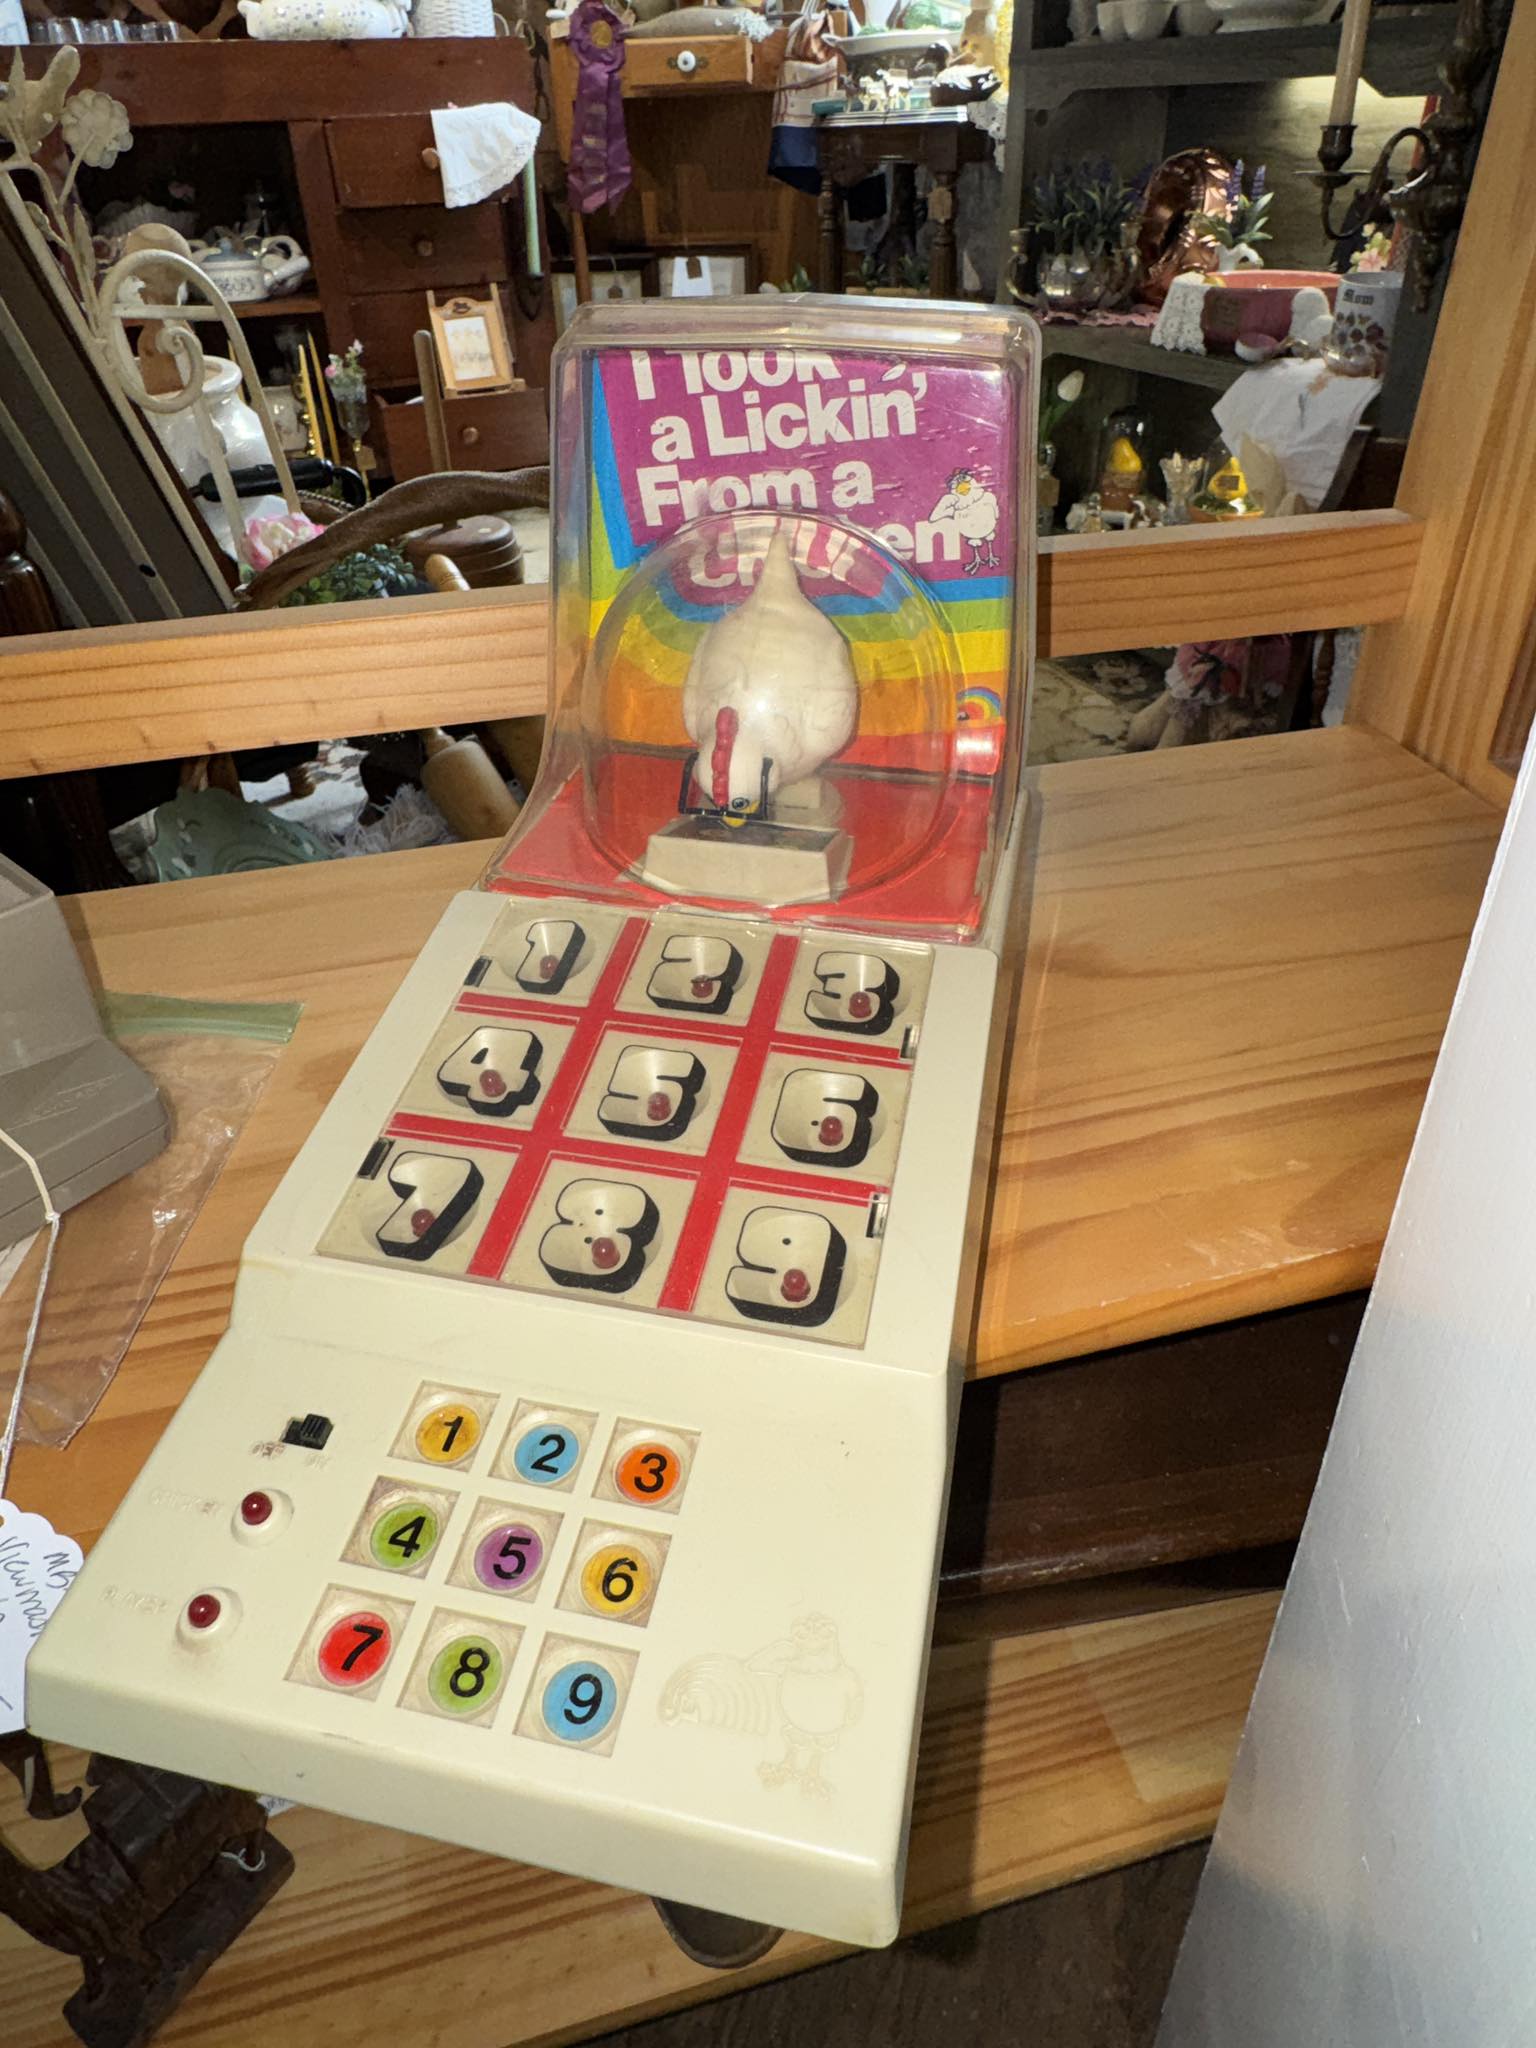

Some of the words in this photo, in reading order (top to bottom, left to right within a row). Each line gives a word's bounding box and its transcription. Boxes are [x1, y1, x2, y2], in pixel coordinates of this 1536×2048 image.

[651, 415, 695, 463] a
[636, 464, 817, 527] From
[831, 461, 875, 508] a
[515, 919, 586, 995] 1
[646, 934, 744, 1015] 2
[803, 951, 901, 1036] 3
[436, 1025, 544, 1118] 4
[597, 1044, 707, 1142] 5
[770, 1068, 881, 1168] 6
[376, 1150, 485, 1262] 7
[538, 1177, 660, 1294] 8
[725, 1205, 848, 1328] 9
[442, 1415, 466, 1453] 1
[531, 1433, 567, 1475] 2
[633, 1452, 668, 1494] 3
[387, 1516, 427, 1559] 4
[492, 1536, 532, 1581] 5
[601, 1558, 639, 1604] 6
[341, 1624, 384, 1672] 7
[448, 1647, 491, 1699] 8
[563, 1673, 604, 1726] 9
